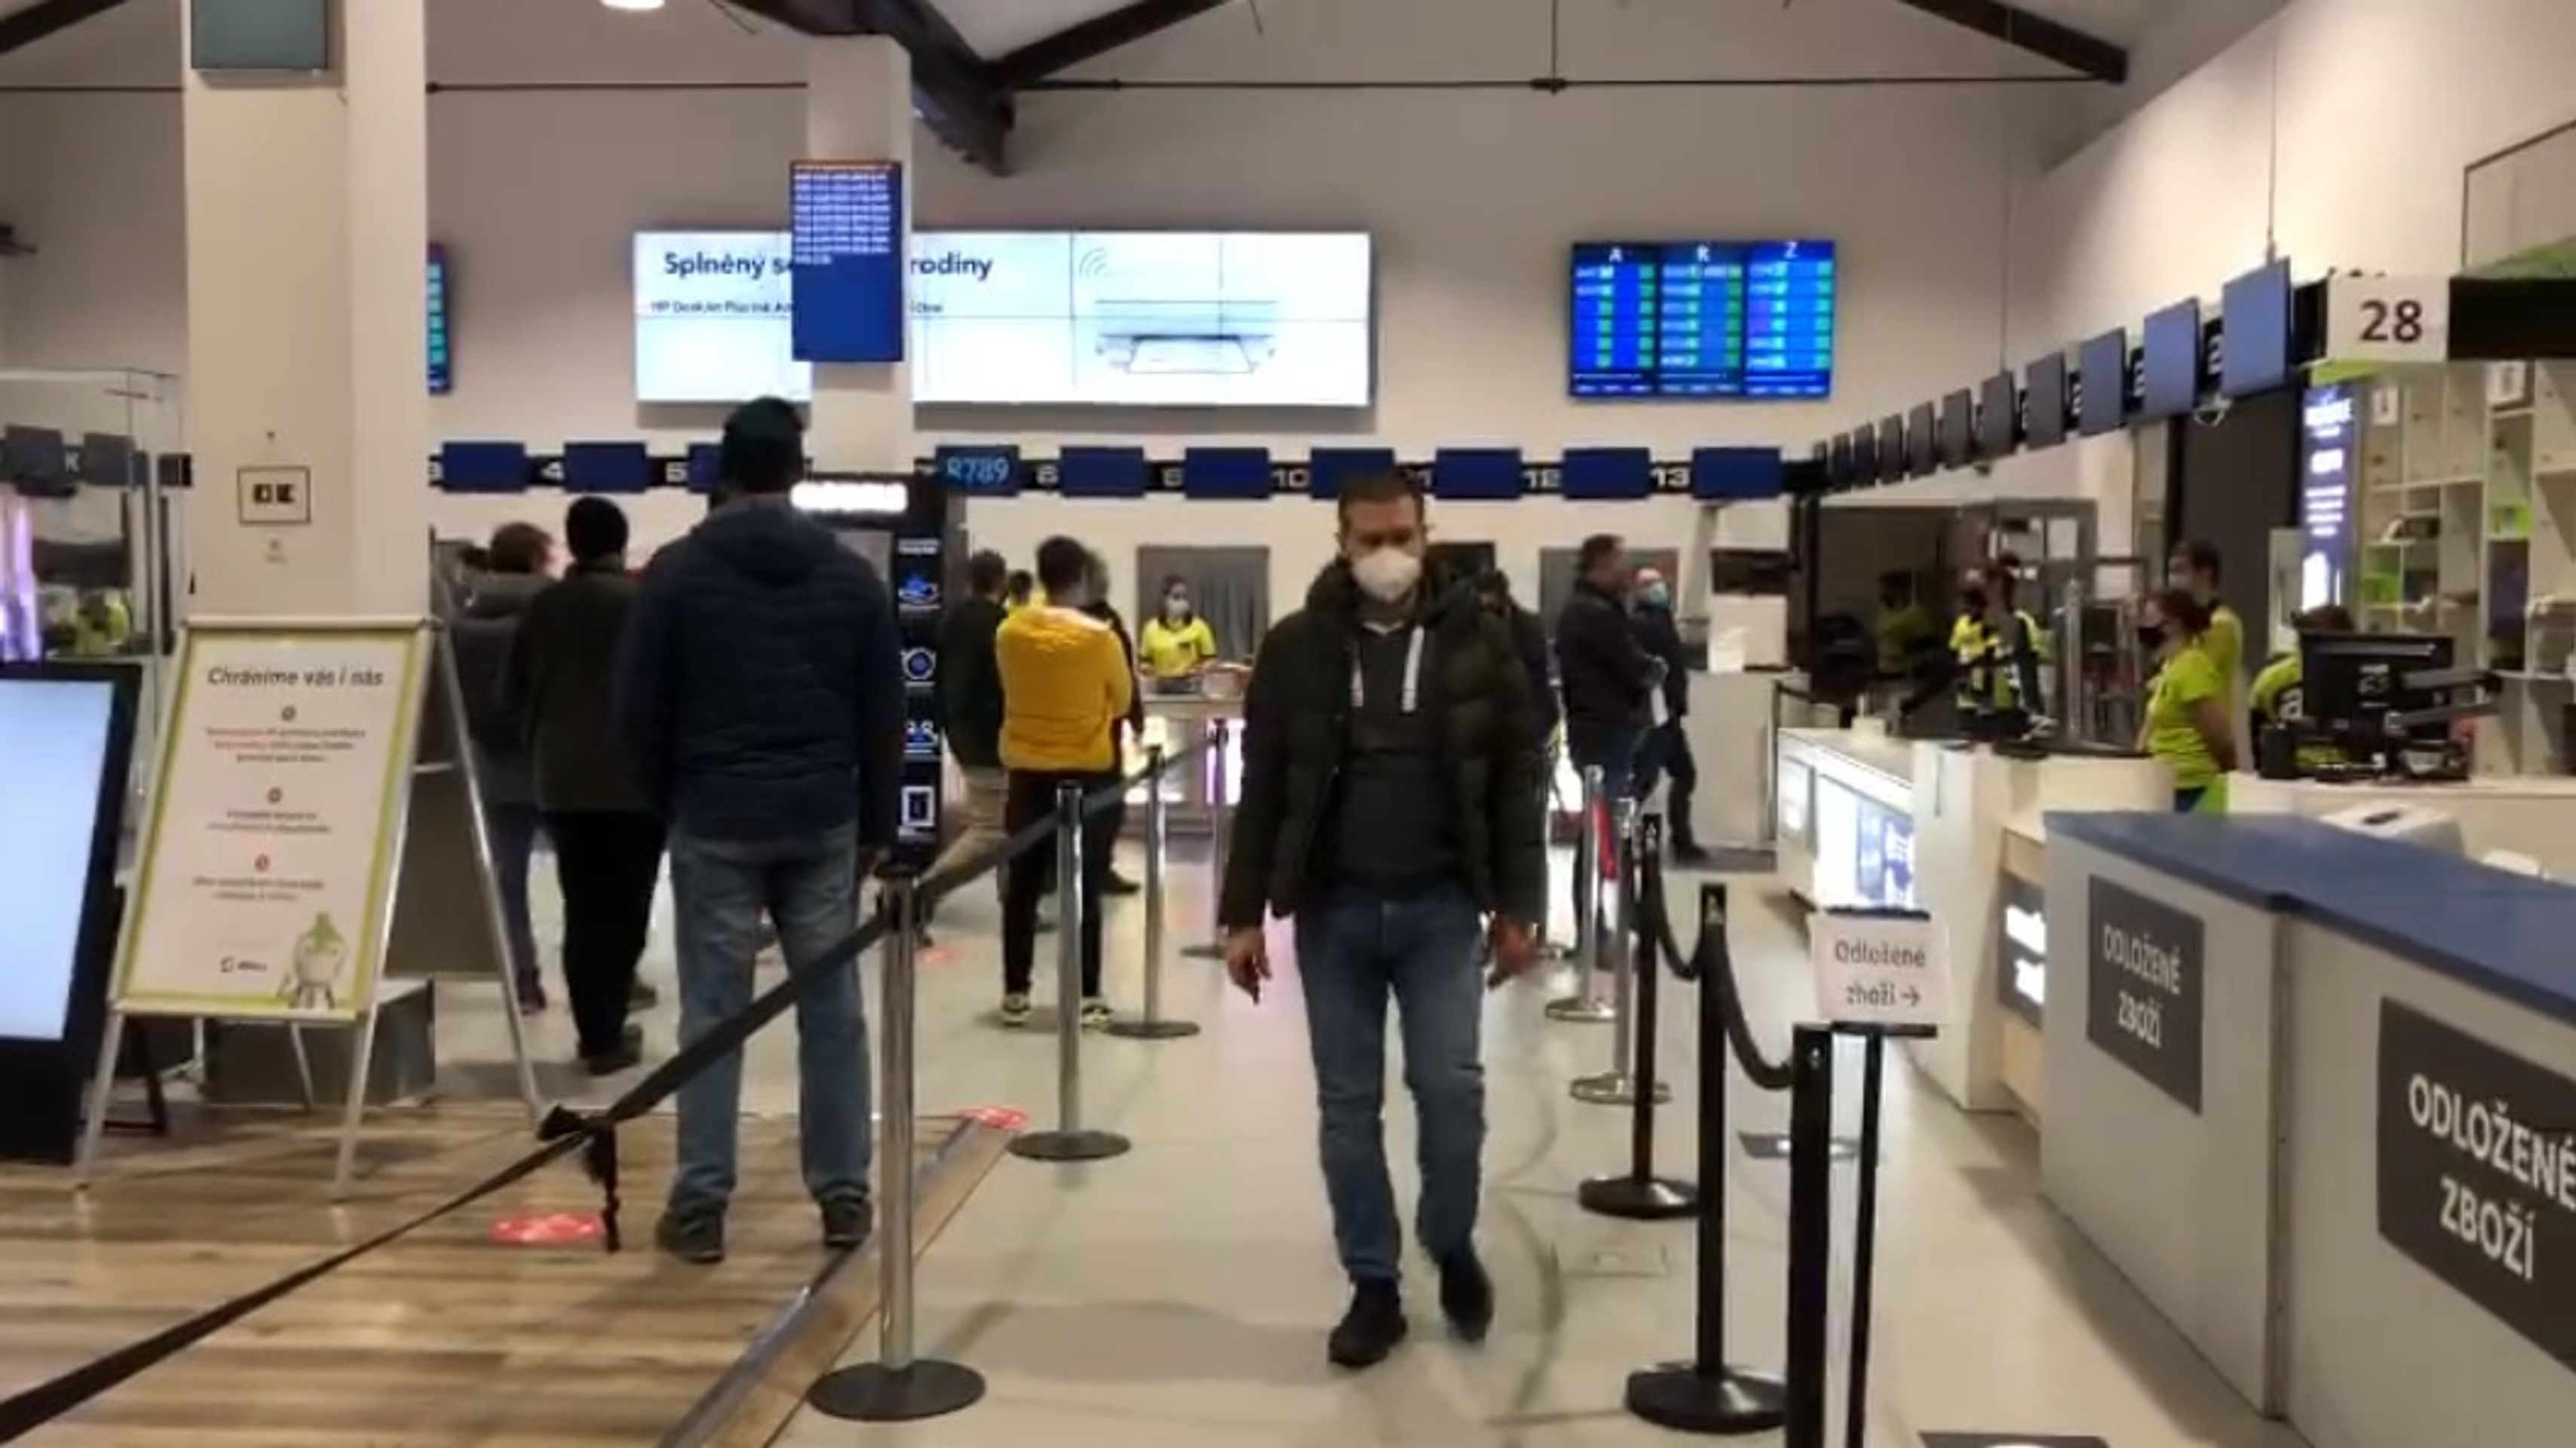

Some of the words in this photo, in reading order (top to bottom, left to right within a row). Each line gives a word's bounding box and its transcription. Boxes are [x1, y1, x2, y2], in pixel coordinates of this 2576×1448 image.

[909, 251, 992, 280] rodiny
[2359, 299, 2424, 344] 28
[946, 456, 1010, 483] R789
[1271, 468, 1310, 487] 10
[1649, 466, 1691, 488] 13
[1835, 939, 1926, 968] Odložené
[2103, 922, 2181, 996] ODLOŽENÉ
[2118, 989, 2164, 1049] ZBOŽÍ
[2409, 1072, 2576, 1212] ODLOŽENÉ
[2439, 1173, 2536, 1283] ZBOŽÍ
